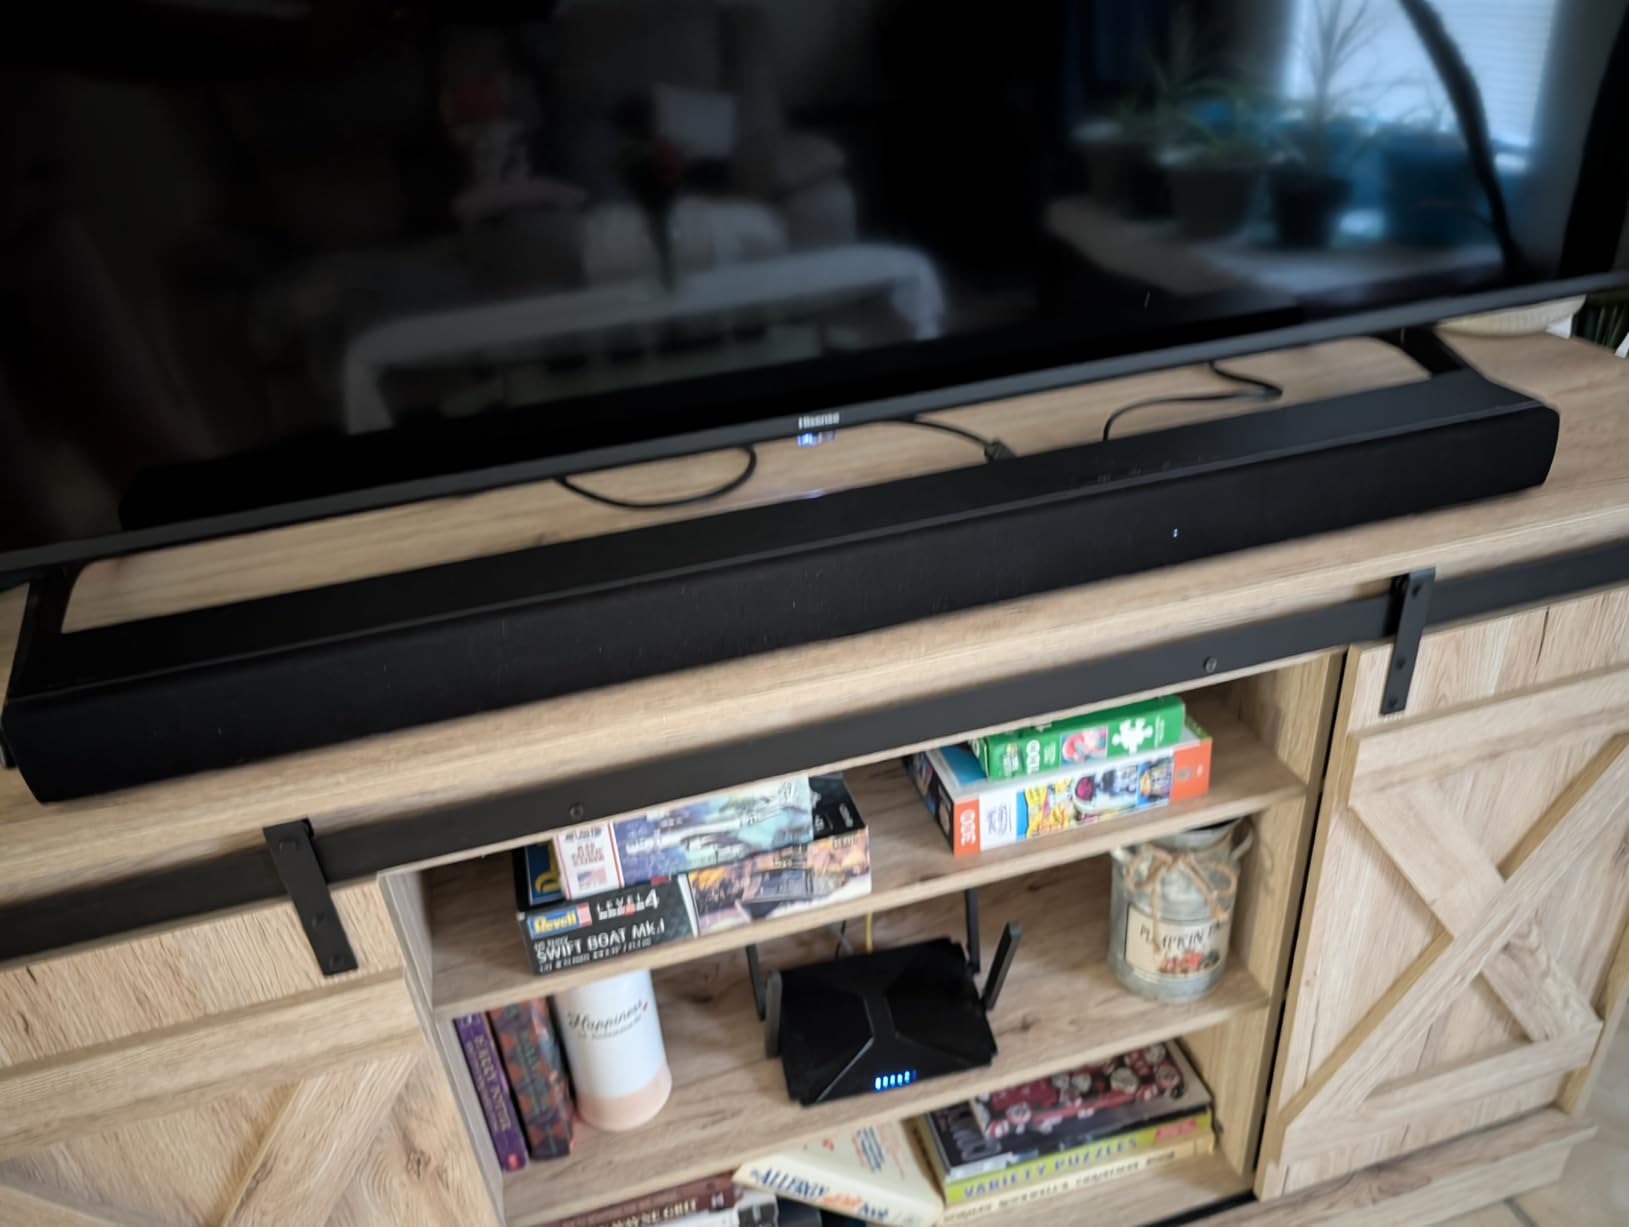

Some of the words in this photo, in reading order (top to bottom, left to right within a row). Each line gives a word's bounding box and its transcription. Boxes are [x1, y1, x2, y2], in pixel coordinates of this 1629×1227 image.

[645, 889, 661, 909] 4
[537, 940, 582, 963] SWIFT
[587, 927, 626, 951] BOAT
[963, 1163, 1047, 1198] VARIETY
[1054, 1136, 1137, 1171] PUZZLES
